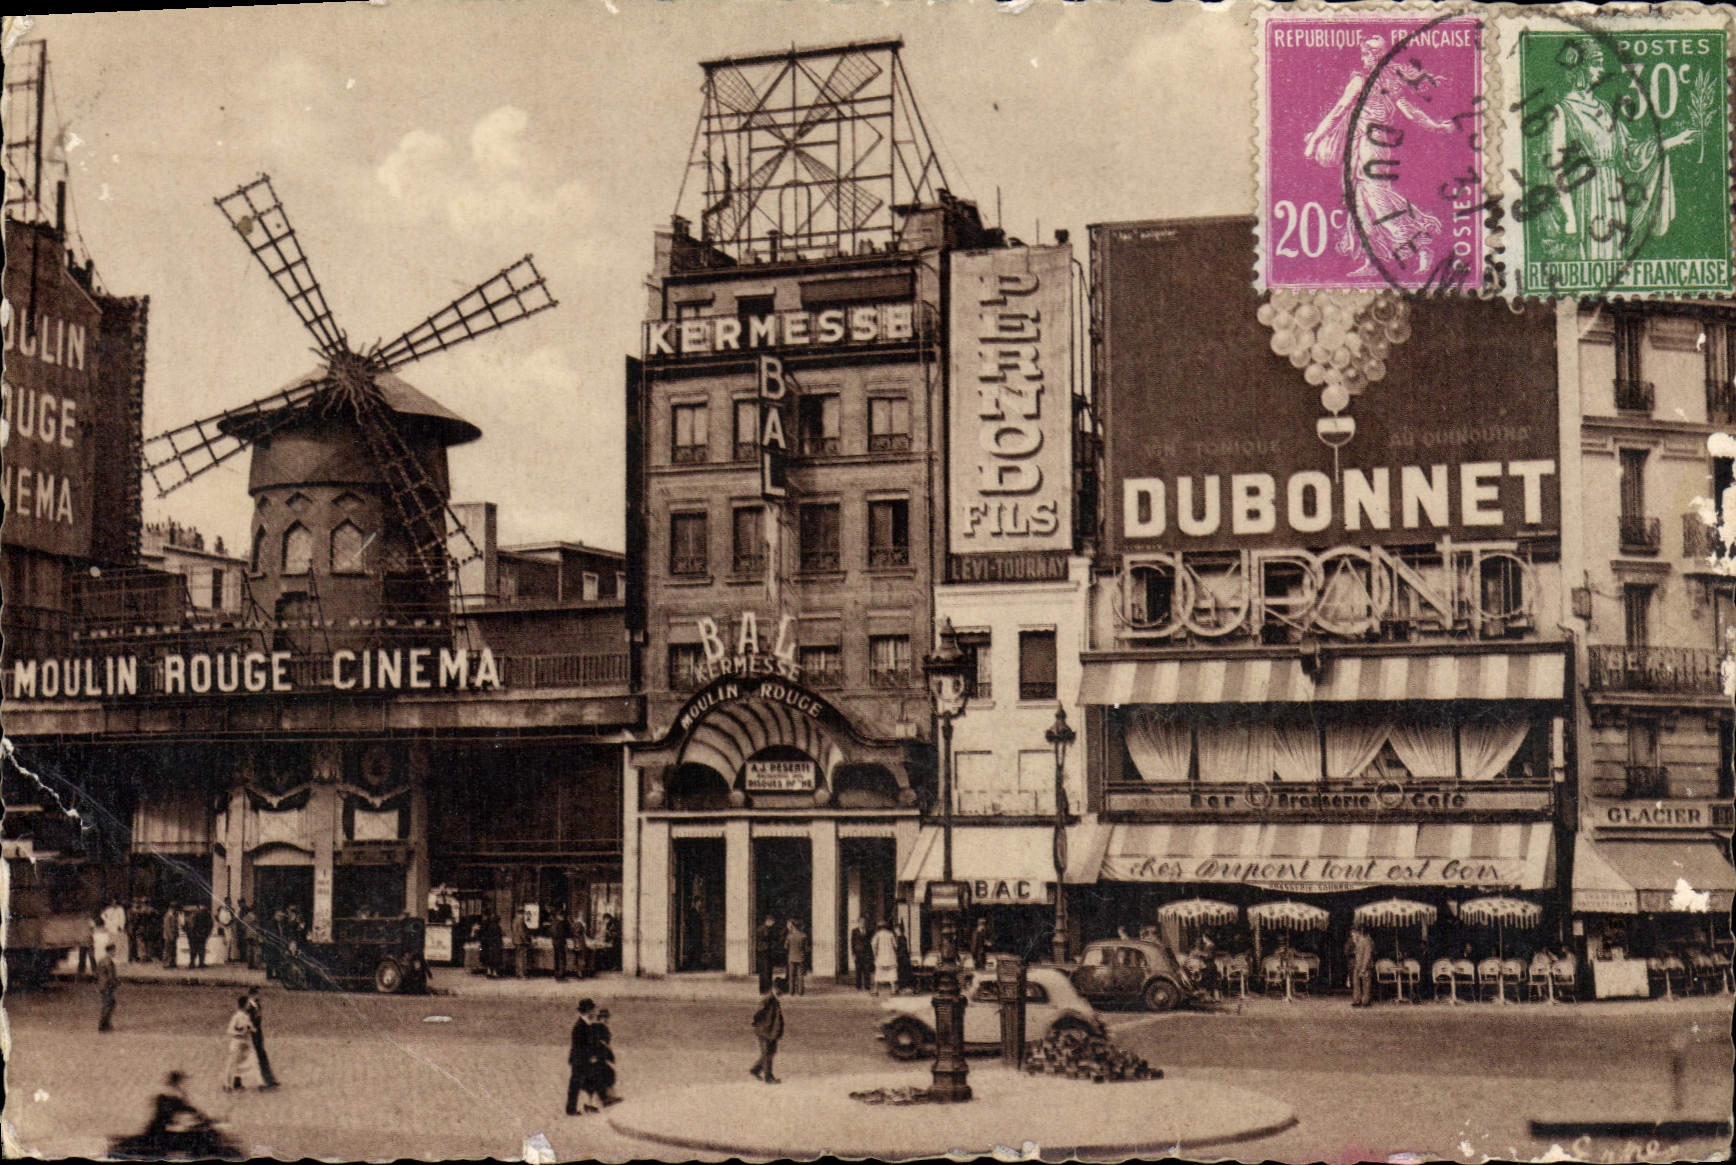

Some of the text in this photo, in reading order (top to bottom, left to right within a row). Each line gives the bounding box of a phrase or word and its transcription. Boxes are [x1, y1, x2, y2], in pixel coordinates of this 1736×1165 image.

[1275, 28, 1472, 49] REPUBLIQUE FRANÇAISE
[1617, 38, 1710, 57] POSTES
[1451, 185, 1473, 272] POSTES
[1529, 260, 1726, 286] REPUBLIQUE FRANÇAISE
[3, 303, 85, 371] OULIN
[649, 303, 913, 355] KERMESSE
[976, 265, 1046, 498] PERNOD
[760, 355, 786, 497] BAL
[961, 501, 1060, 540] FILS
[1123, 459, 1555, 538] DUBONNET
[698, 611, 797, 661] BAL
[14, 647, 500, 699] MOULIN ROUGE CINEMA
[694, 655, 801, 683] KERMESSE
[681, 682, 822, 730] MOULIN ROUGE
[1607, 807, 1701, 824] GLACIER
